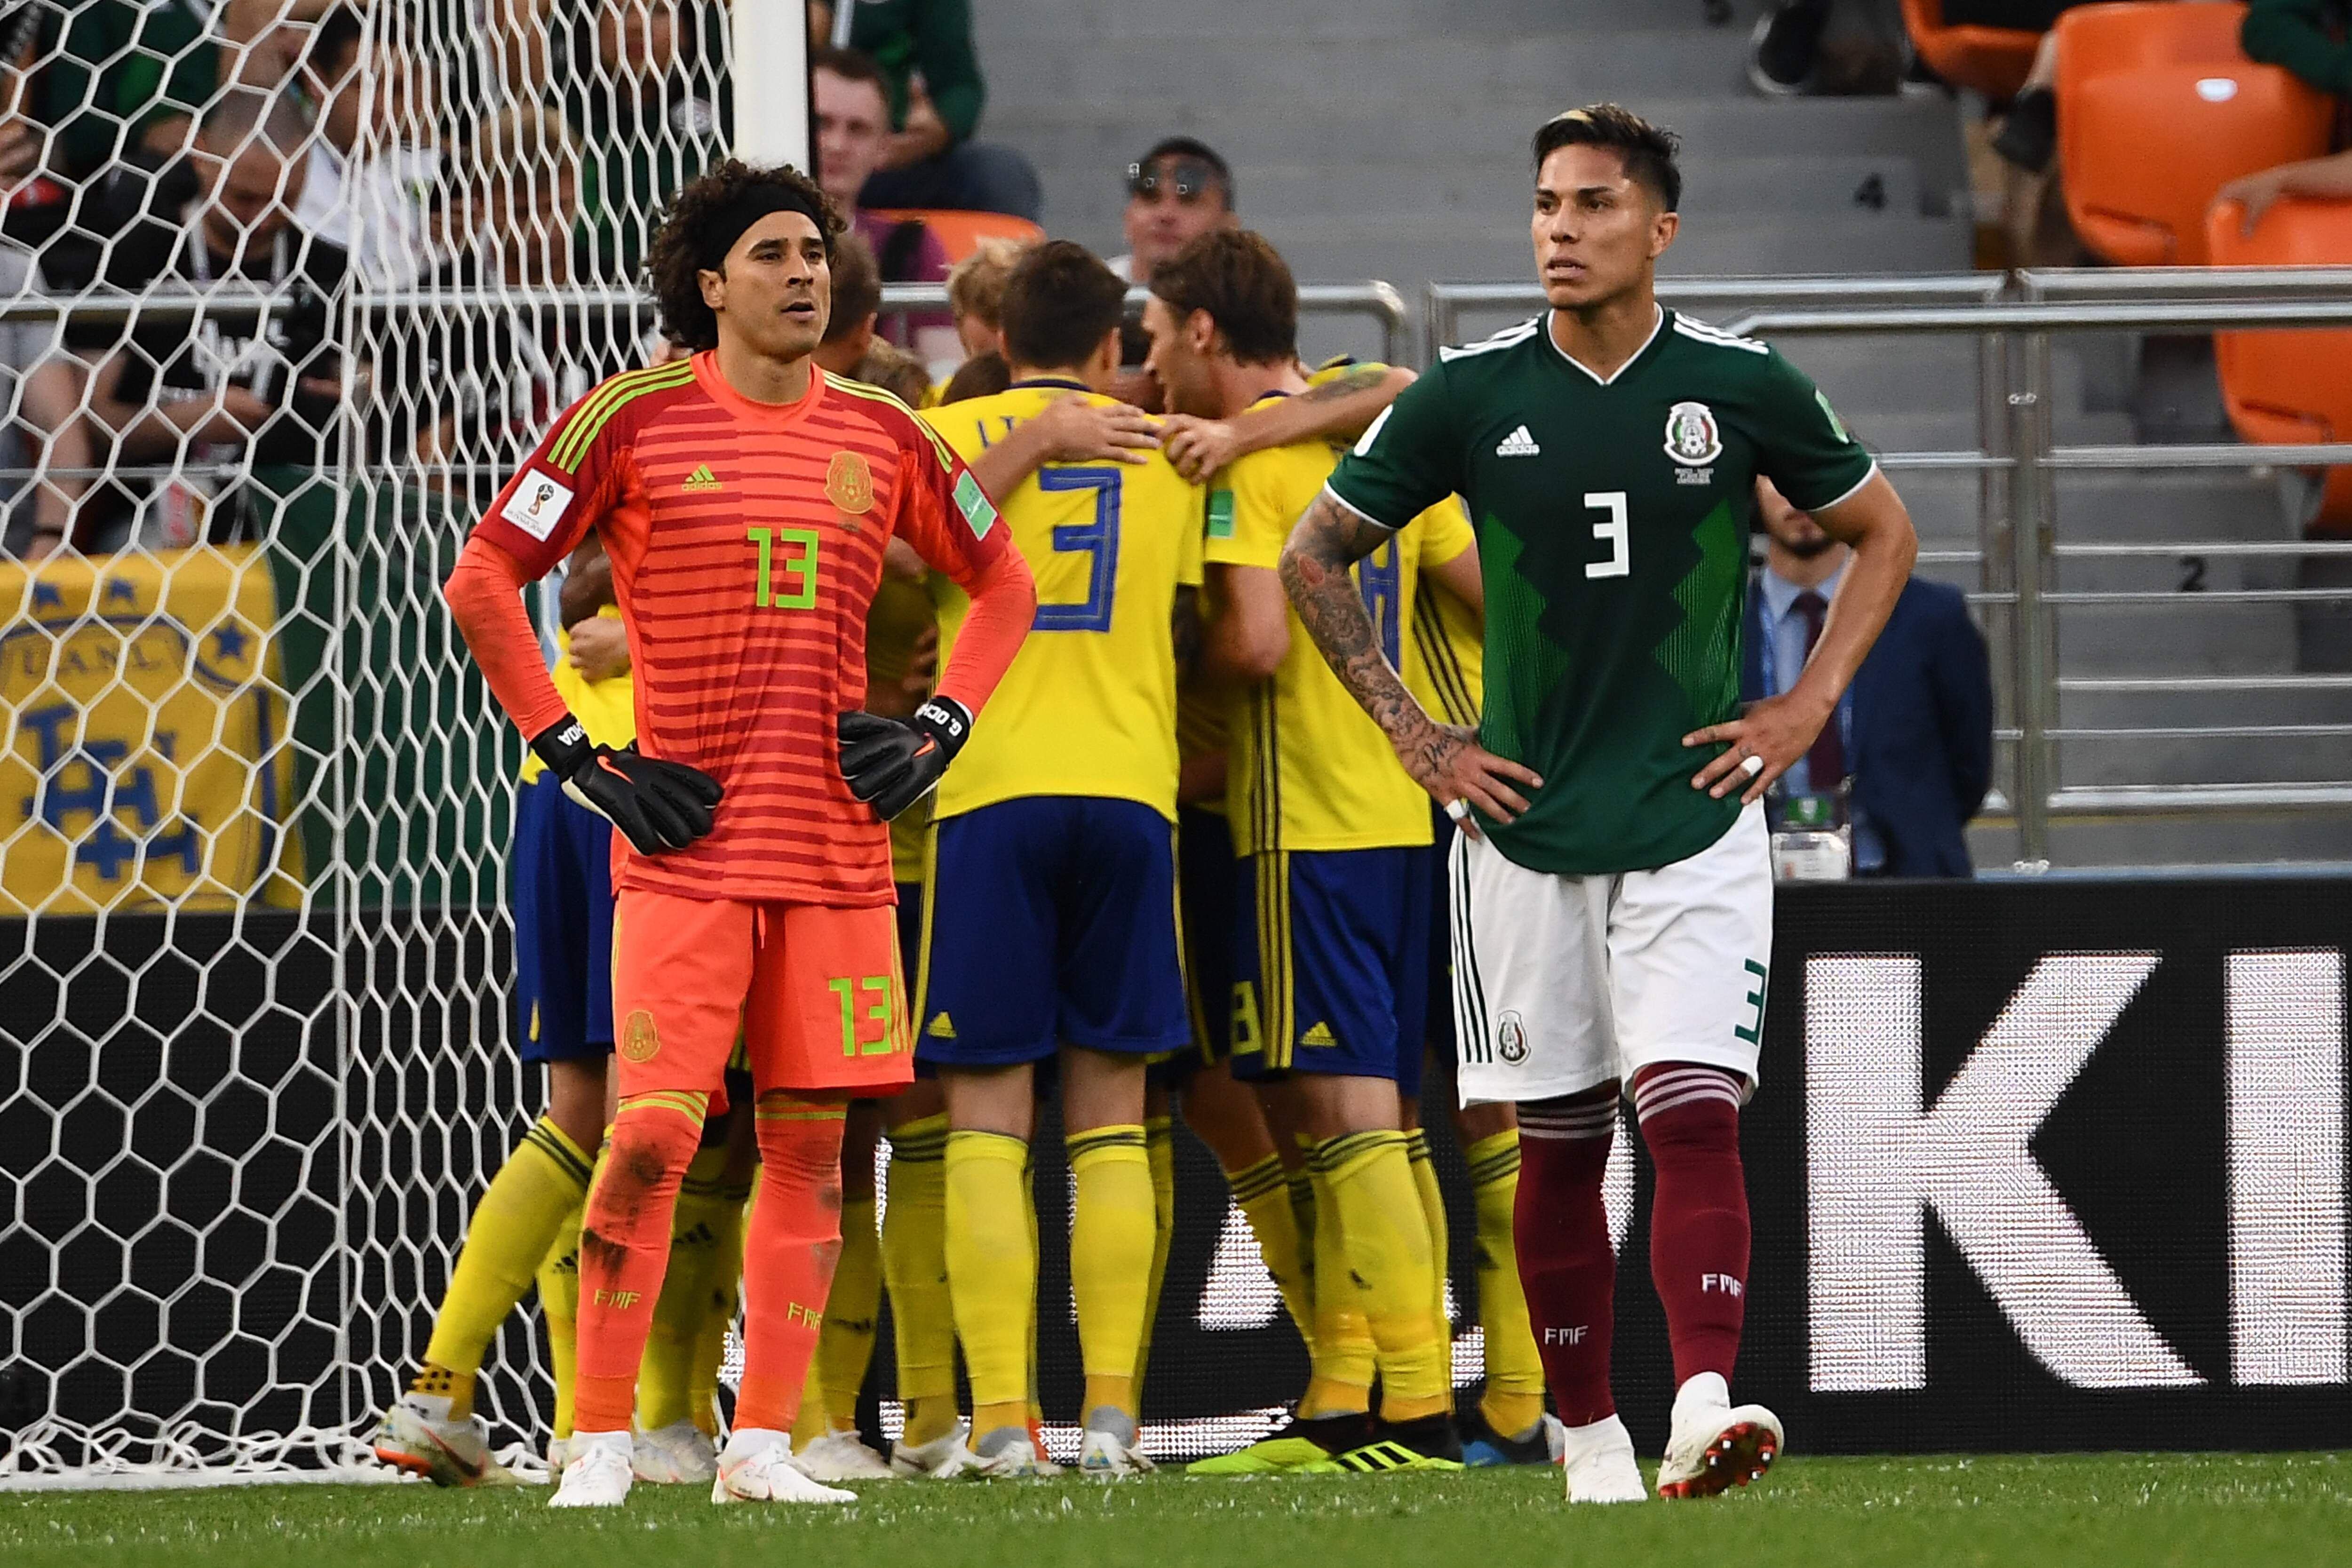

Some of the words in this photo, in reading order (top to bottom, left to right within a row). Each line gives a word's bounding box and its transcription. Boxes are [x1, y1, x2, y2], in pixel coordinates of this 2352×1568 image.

[1496, 444, 1540, 456] adidas
[1031, 467, 1121, 632] 3
[1584, 491, 1629, 579] 3
[747, 528, 818, 609] 13
[2178, 555, 2206, 592] 2
[914, 701, 950, 725] OCH
[949, 718, 962, 736] G.
[829, 976, 893, 1056] 13
[1734, 958, 1767, 1046] 3
[1804, 947, 2352, 1392] KI
[594, 1289, 641, 1309] FMF
[1701, 1274, 1742, 1297] FMF
[1545, 1326, 1588, 1345] FMF
